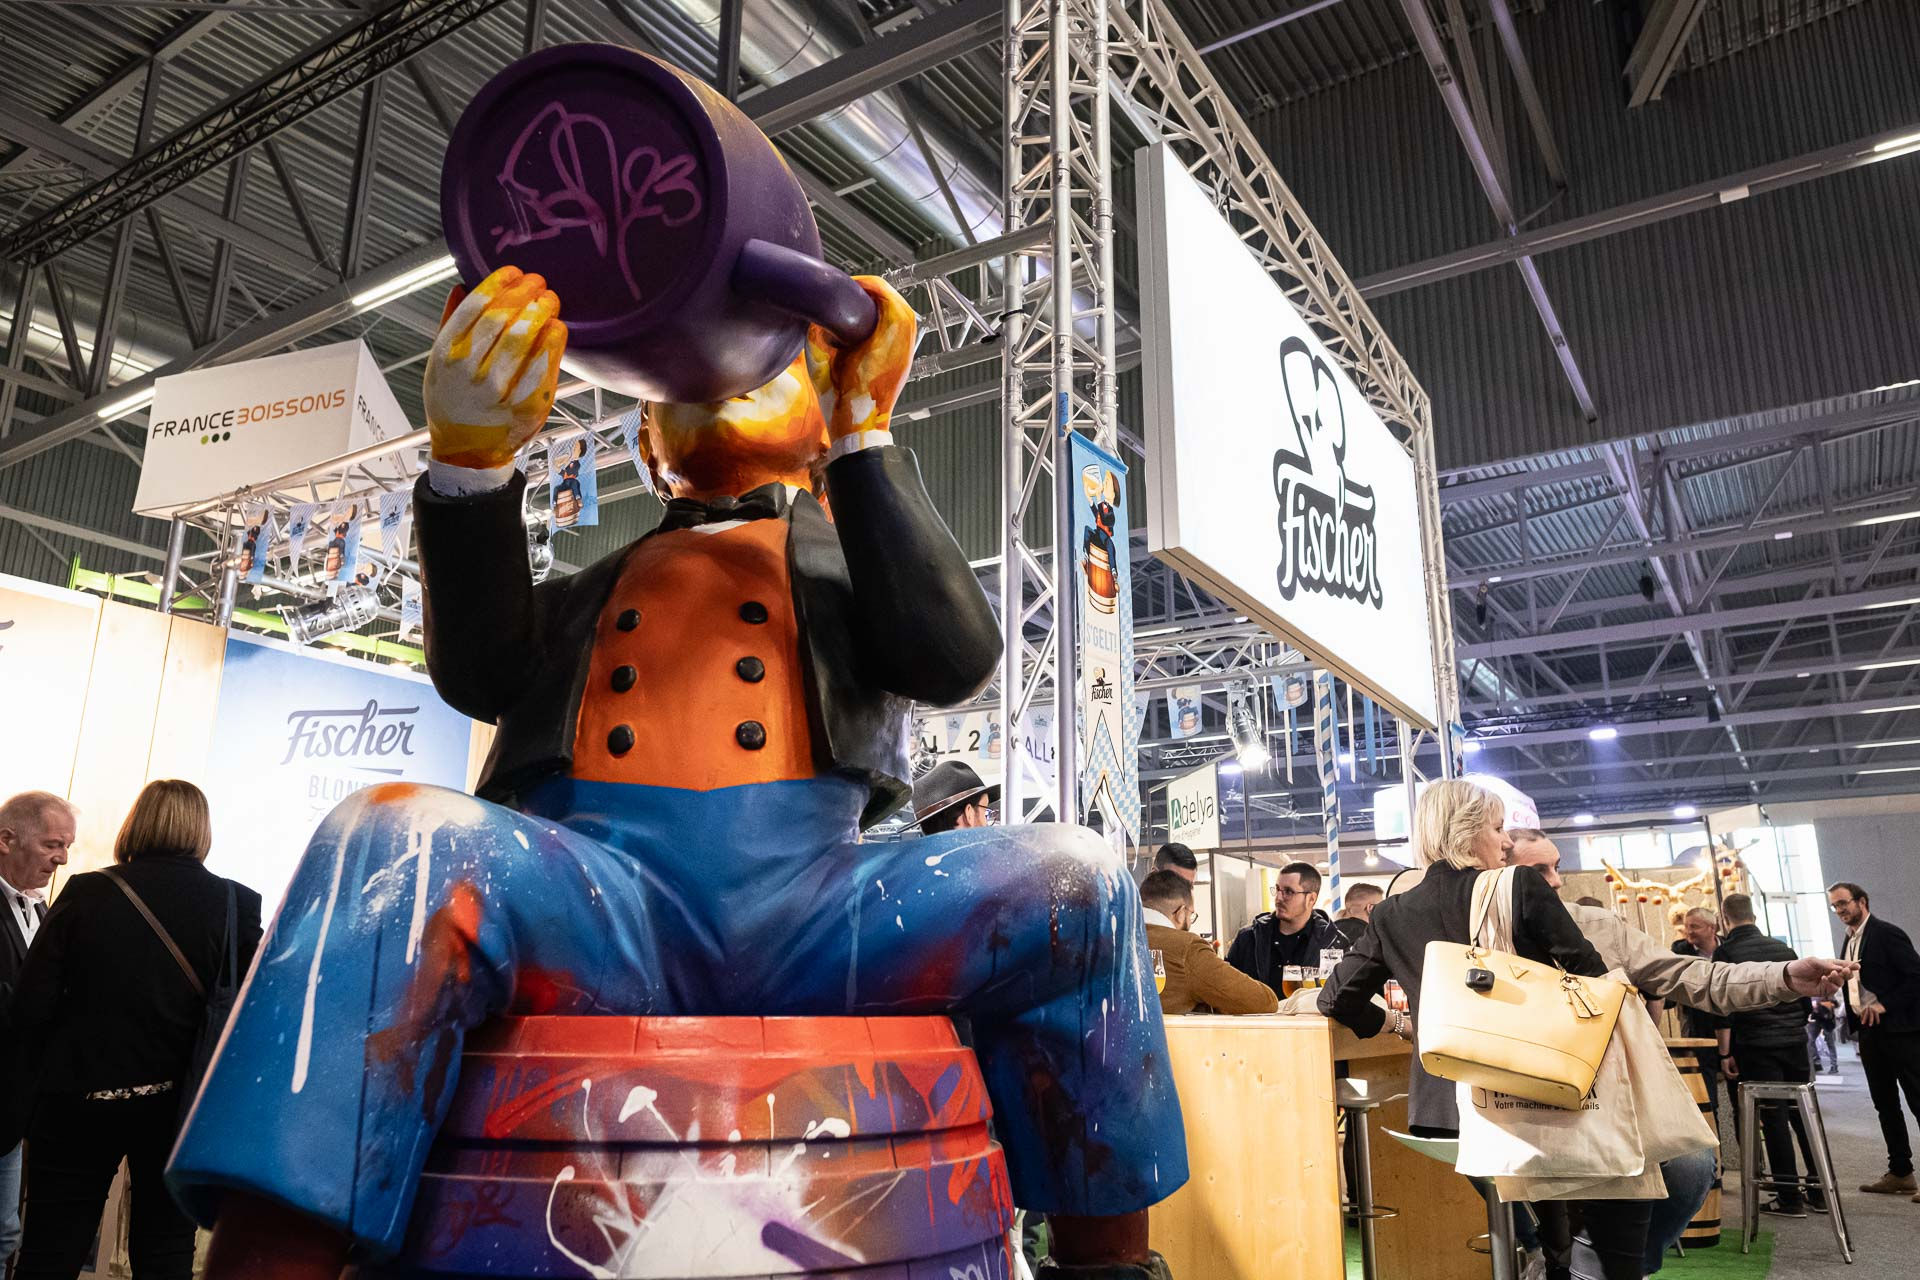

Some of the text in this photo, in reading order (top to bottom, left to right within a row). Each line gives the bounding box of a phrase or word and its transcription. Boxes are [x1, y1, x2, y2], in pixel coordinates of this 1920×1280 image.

[152, 388, 346, 440] FRANCE BOISSONS
[1276, 460, 1381, 602] Fischer
[1086, 623, 1118, 655] S'GELT!
[1091, 682, 1114, 702] Fischer
[280, 699, 420, 766] Fischer
[1170, 790, 1214, 829] Adelya
[1494, 1101, 1514, 1110] Votre
